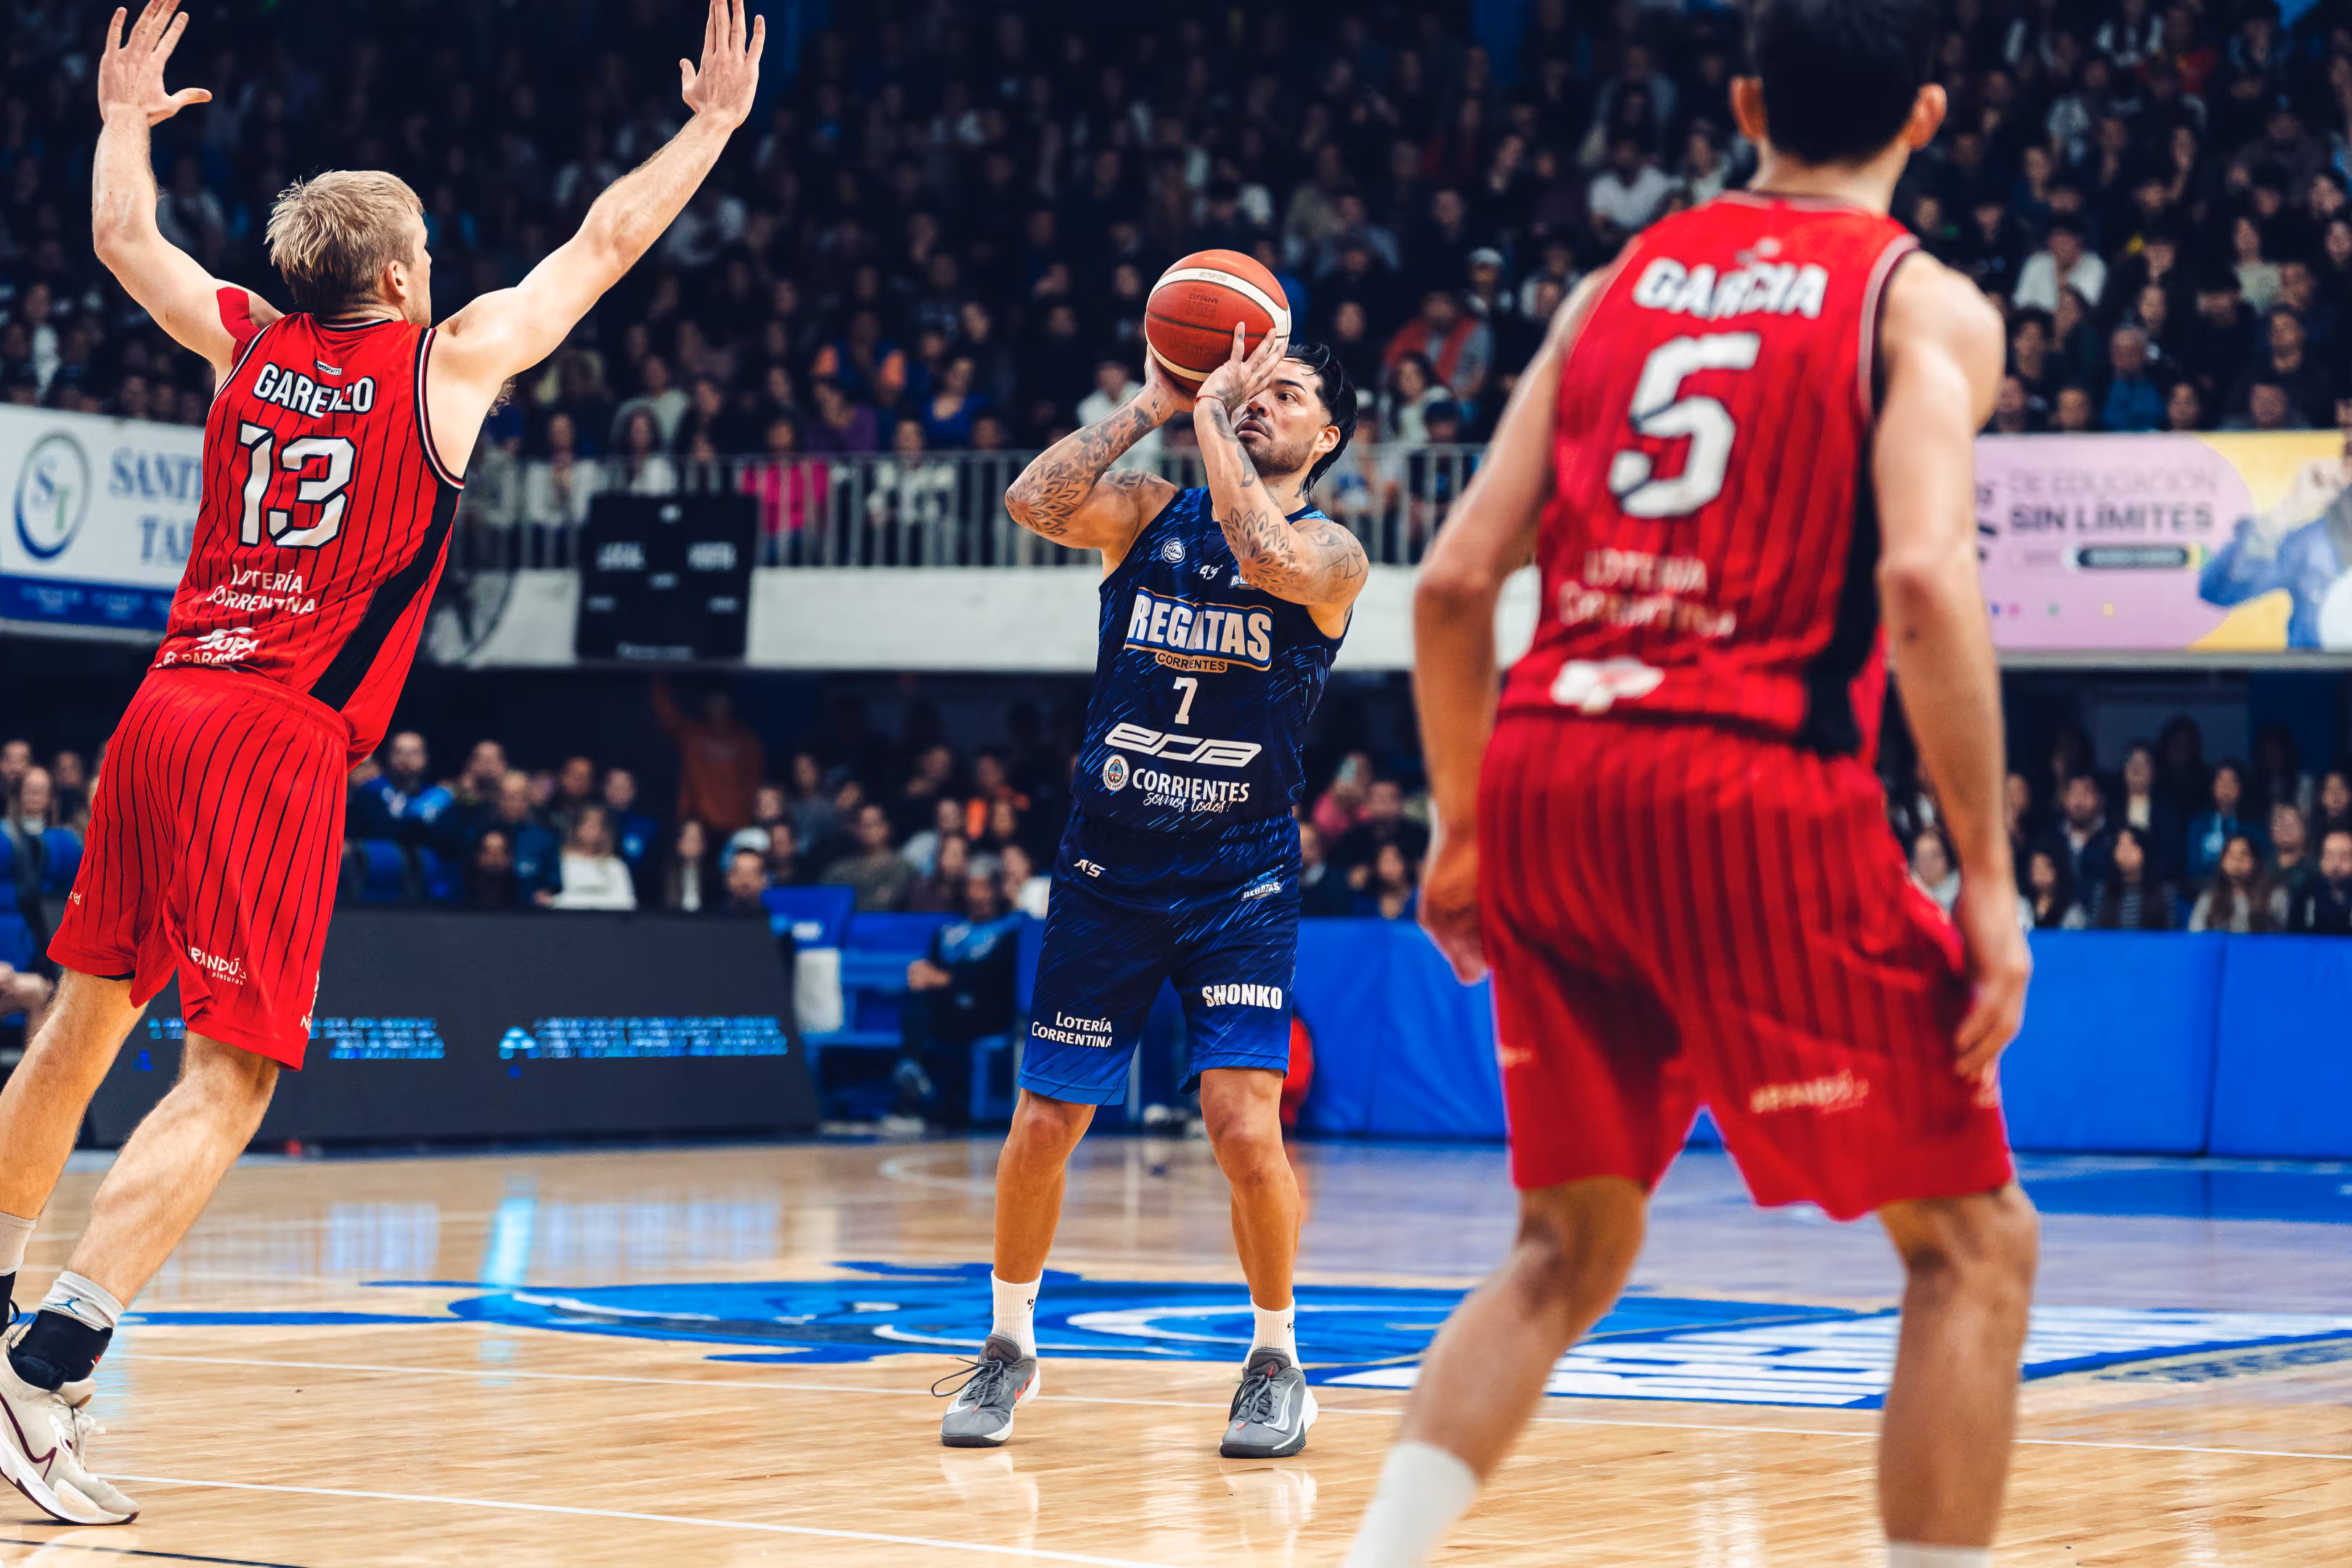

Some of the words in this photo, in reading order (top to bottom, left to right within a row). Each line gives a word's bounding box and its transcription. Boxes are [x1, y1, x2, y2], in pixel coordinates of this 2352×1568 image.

[1608, 332, 1761, 518] 5
[241, 422, 356, 548] 13
[2011, 503, 2067, 532] SIN
[1127, 594, 1272, 661] REGATAS
[1157, 652, 1225, 671] CORRIENTES
[1173, 677, 1198, 724] 7
[1132, 768, 1250, 802] CORRIENTES
[1143, 792, 1187, 812] somos
[212, 971, 243, 986] pinturas
[1202, 984, 1283, 1010] SHONKO
[1032, 1021, 1113, 1048] CORRENTINA
[1055, 1011, 1112, 1033] LOTERÍA
